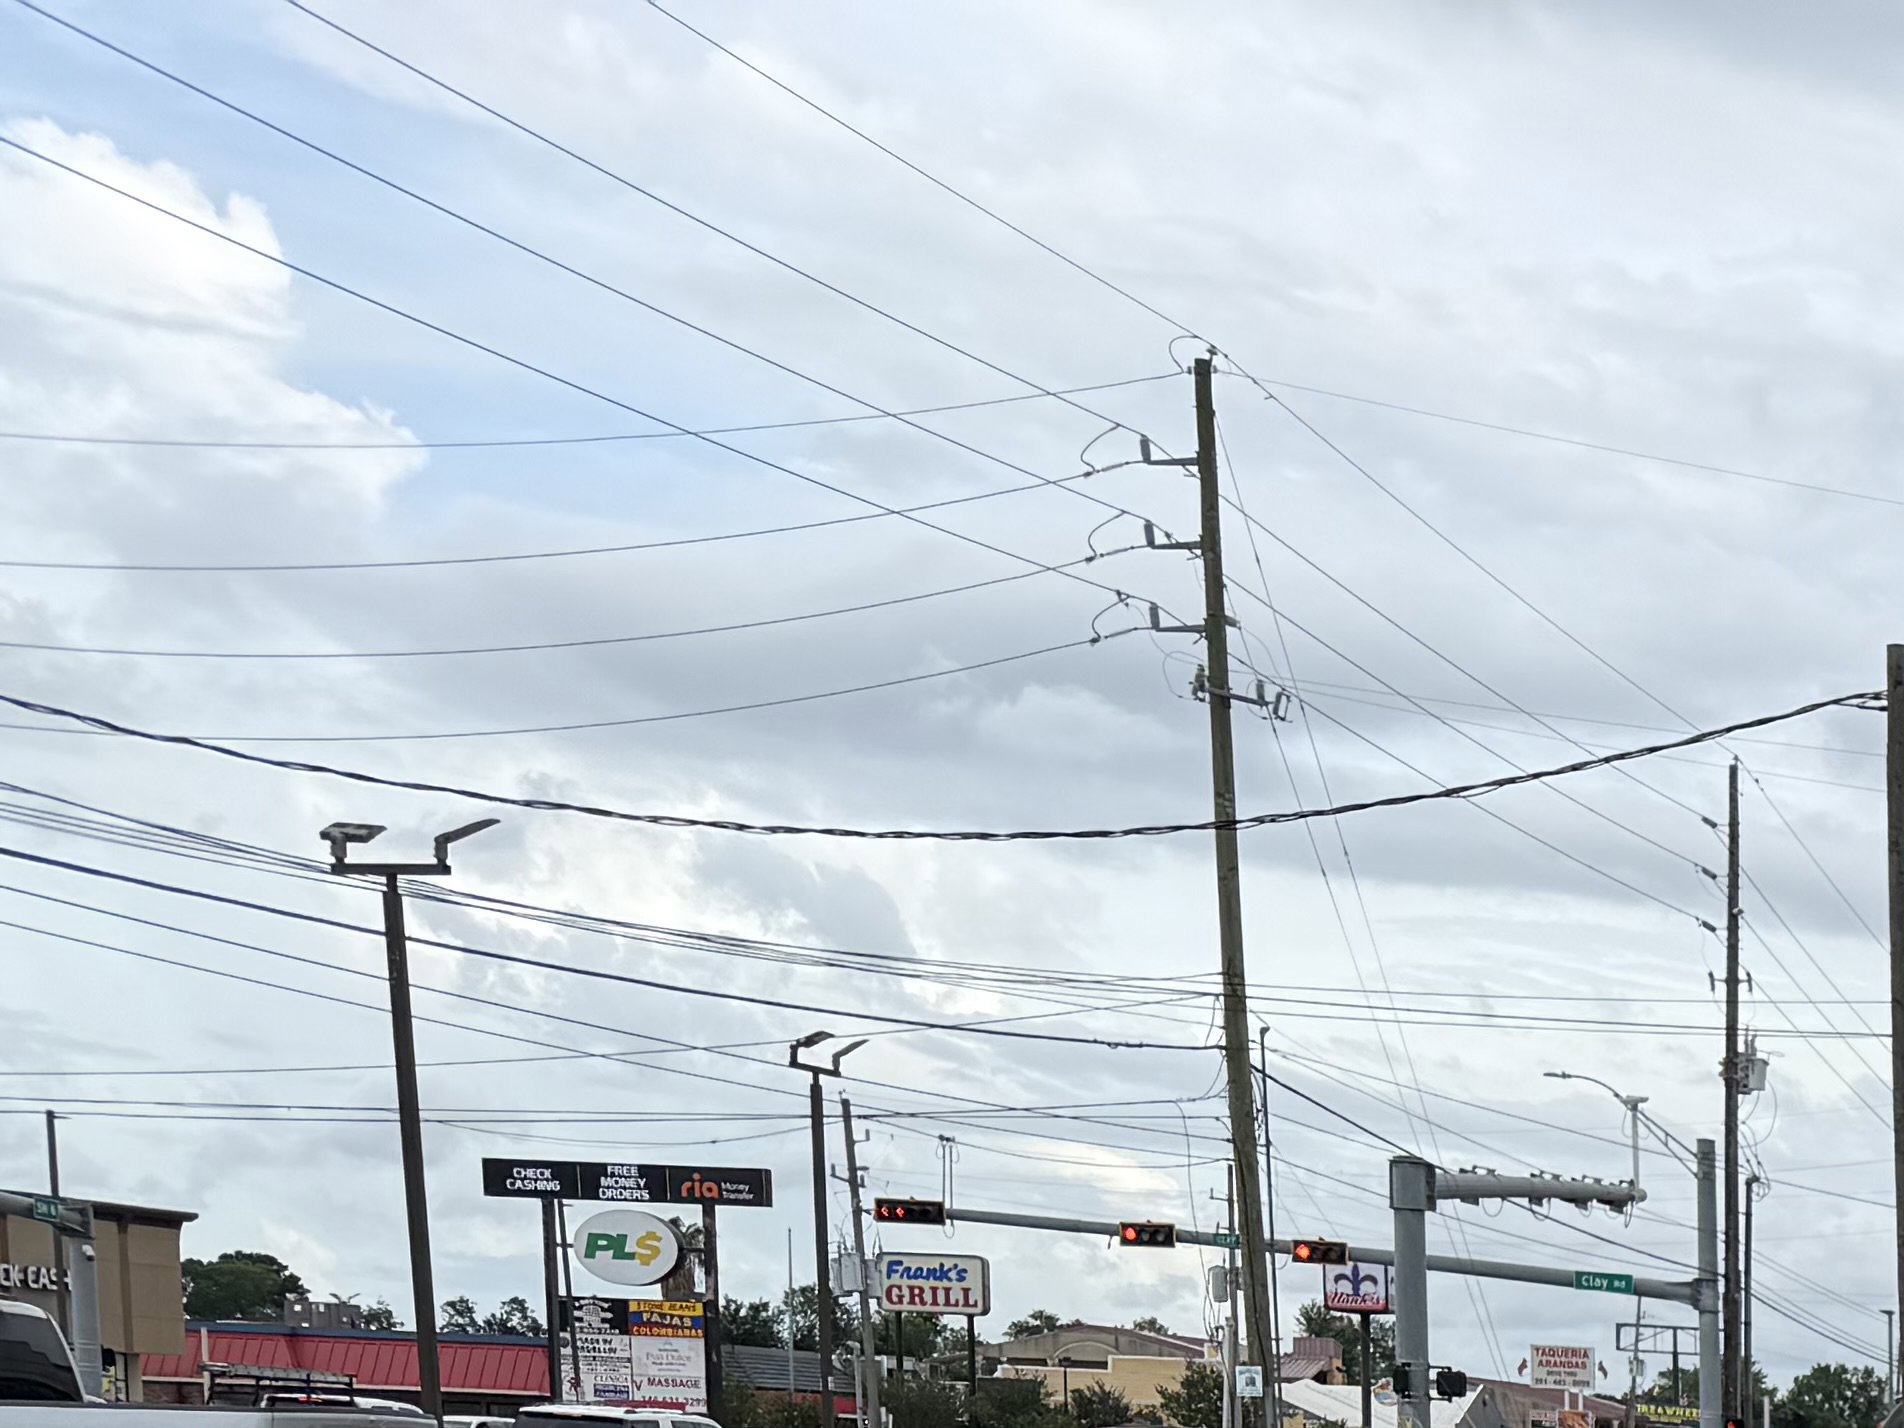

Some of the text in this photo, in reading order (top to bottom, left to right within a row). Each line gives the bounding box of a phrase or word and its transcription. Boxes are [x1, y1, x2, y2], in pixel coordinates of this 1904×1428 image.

[513, 1167, 552, 1179] CHECK
[607, 1165, 639, 1177] FREE
[506, 1179, 561, 1191] CASHING
[600, 1176, 646, 1188] MONEY
[681, 1172, 720, 1199] ria
[599, 1188, 650, 1200] ORDERS
[886, 1260, 968, 1283] Frank's
[1582, 1275, 1608, 1290] Clay
[885, 1284, 978, 1308] GRILL
[642, 1312, 693, 1327] FAJAS
[633, 1326, 704, 1337] COLOMBIANAS
[1534, 1347, 1590, 1360] TAQUERIA
[1537, 1359, 1587, 1370] ARANDAS
